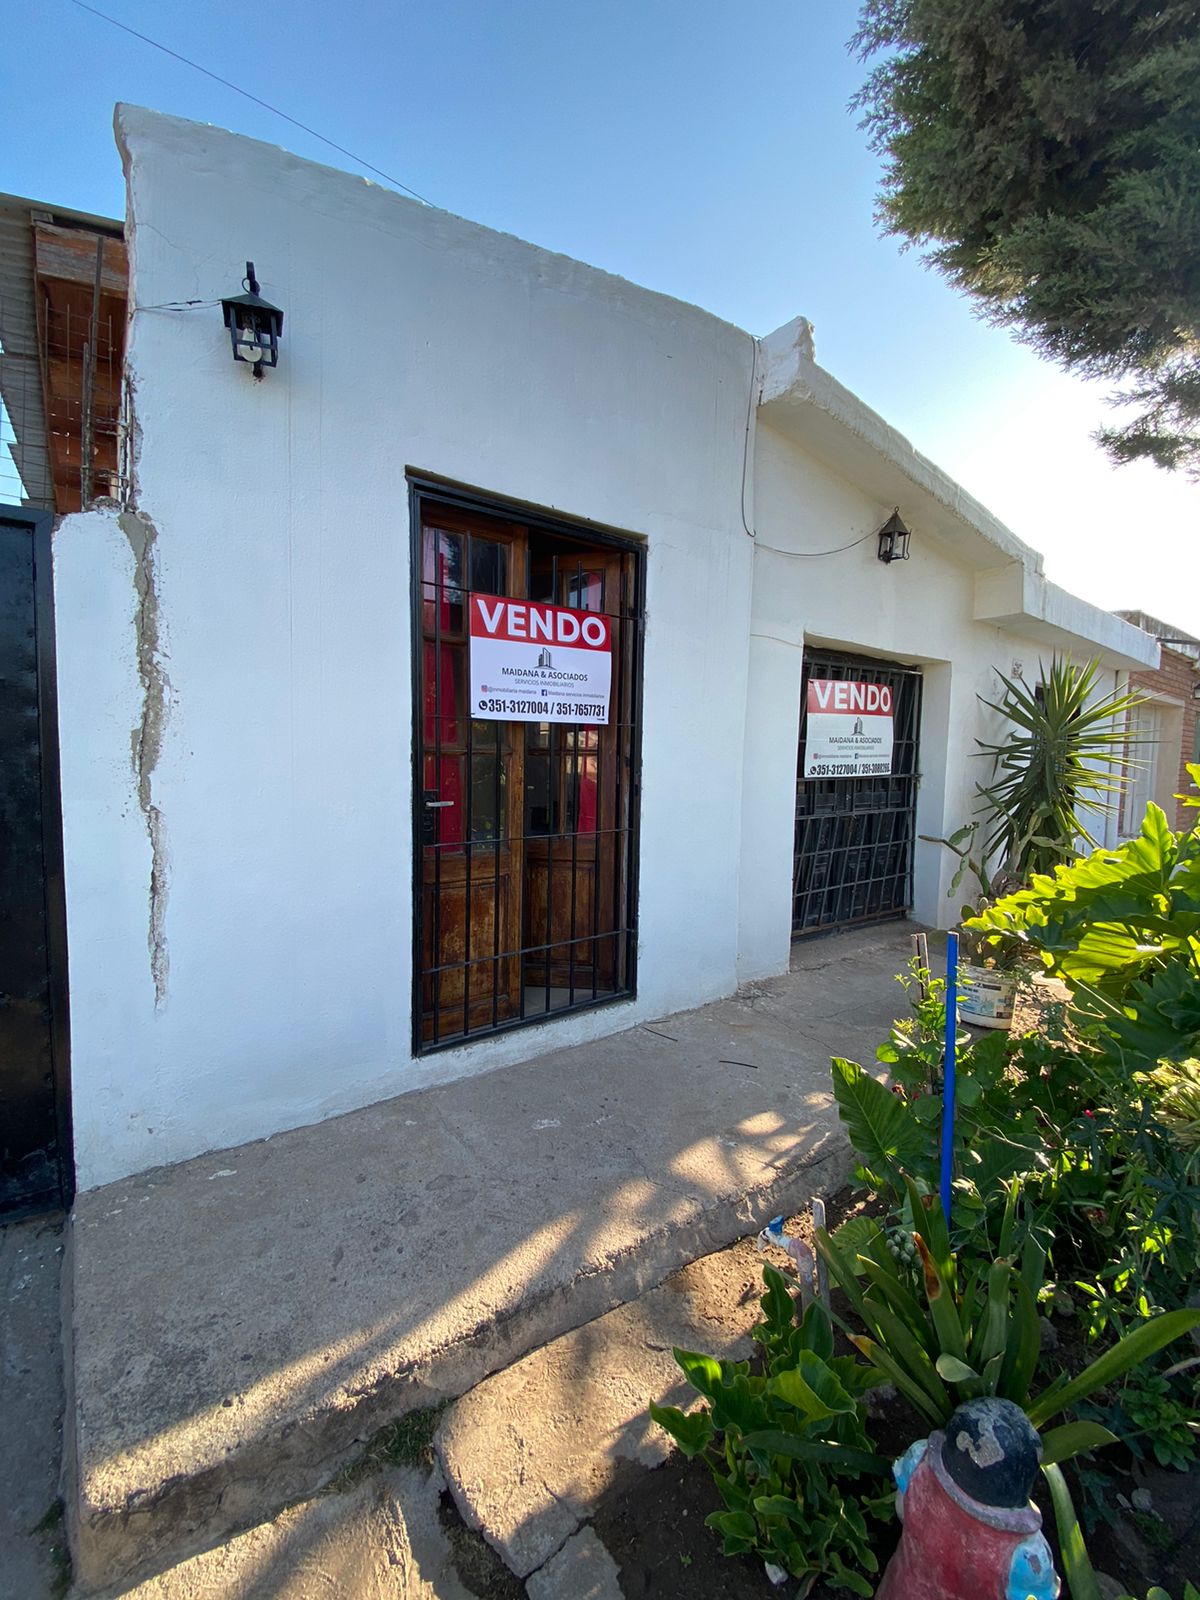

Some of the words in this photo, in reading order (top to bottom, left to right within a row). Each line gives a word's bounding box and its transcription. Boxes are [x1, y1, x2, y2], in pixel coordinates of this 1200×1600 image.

[477, 599, 606, 647] VENDO
[501, 667, 539, 678] MAIDANA
[541, 671, 547, 679] &
[548, 671, 588, 682] ASOCIADOS
[515, 678, 539, 686] SERVICIOS
[540, 680, 575, 688] INMOBILIARIOS
[814, 681, 891, 713] VENDO
[488, 698, 549, 715] 351-3127004
[550, 702, 555, 715] /
[556, 702, 605, 717] 351-7657731
[817, 764, 857, 776] 351-3127004
